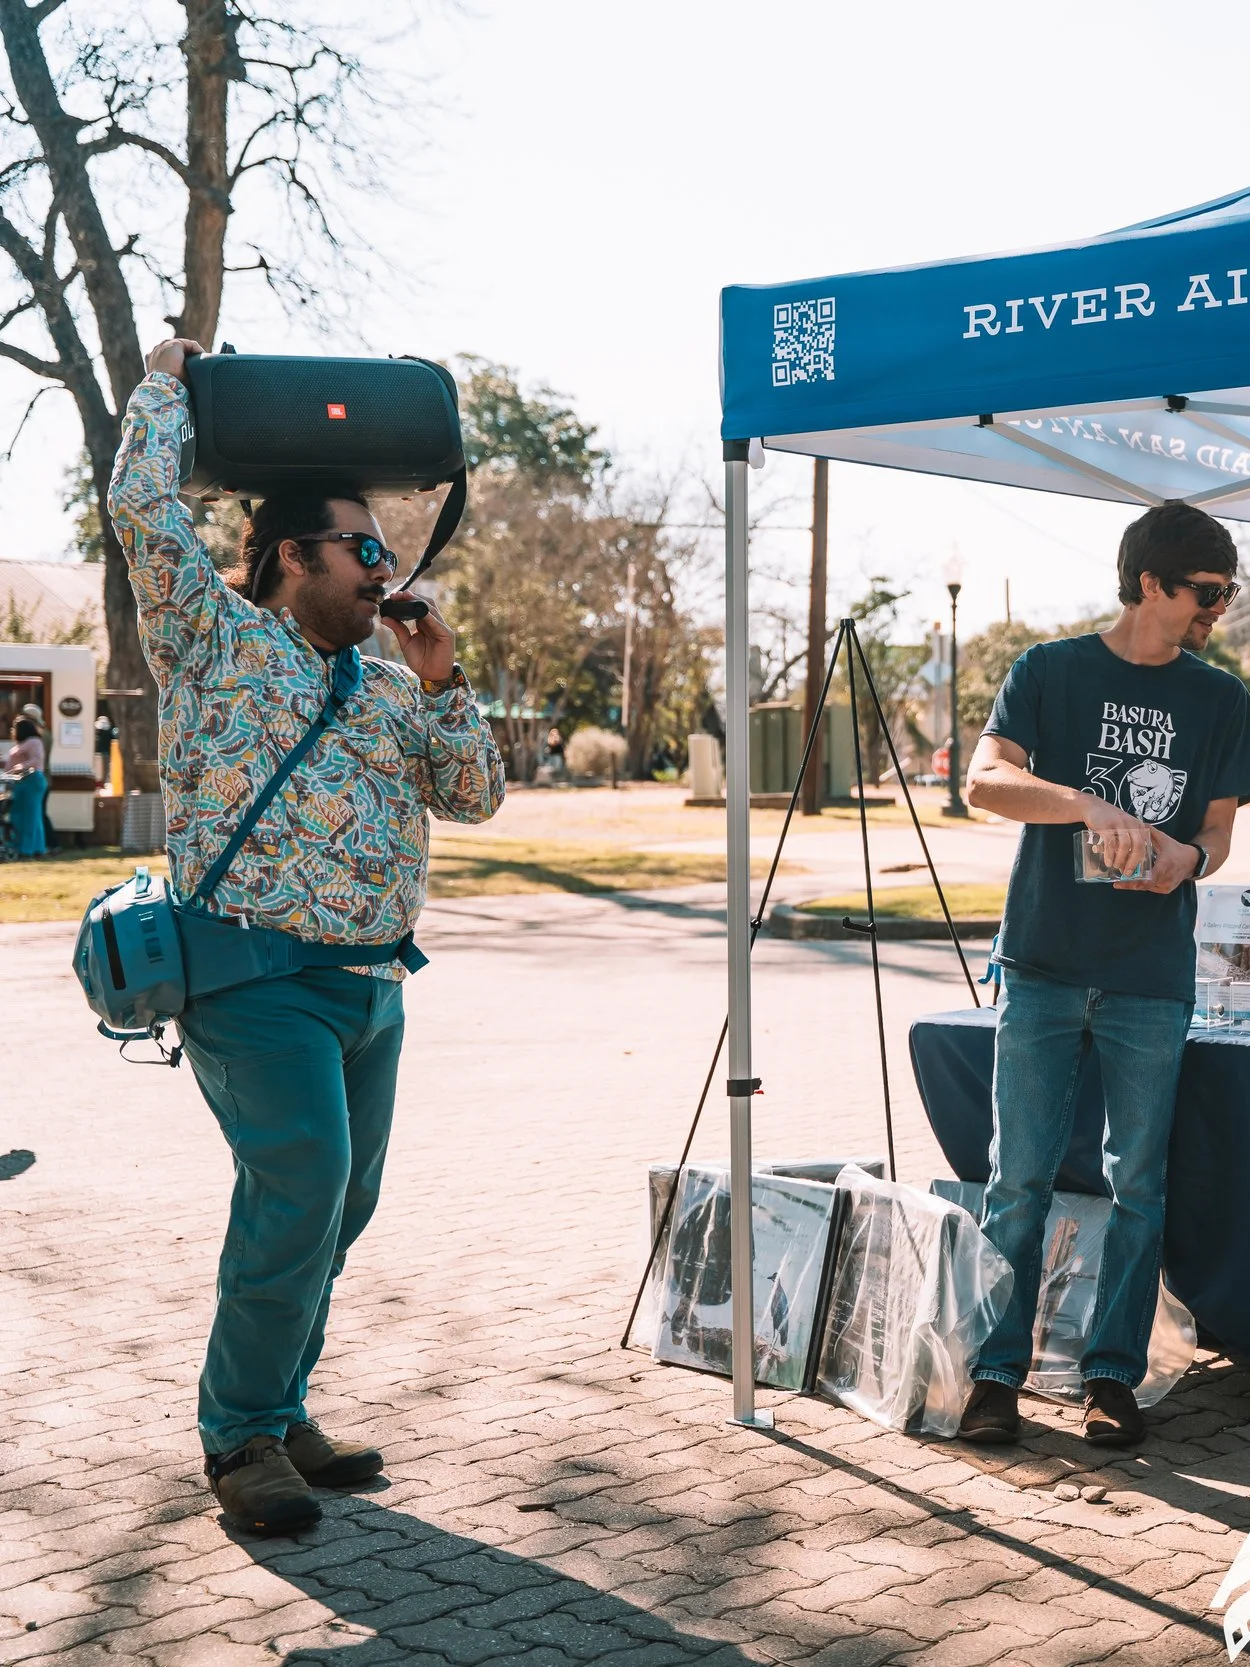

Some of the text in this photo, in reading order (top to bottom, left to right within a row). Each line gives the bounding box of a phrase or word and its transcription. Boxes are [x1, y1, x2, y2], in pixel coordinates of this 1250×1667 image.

[963, 283, 1155, 339] RIVER
[1102, 702, 1175, 732] BASURA
[1098, 722, 1176, 760] BASH
